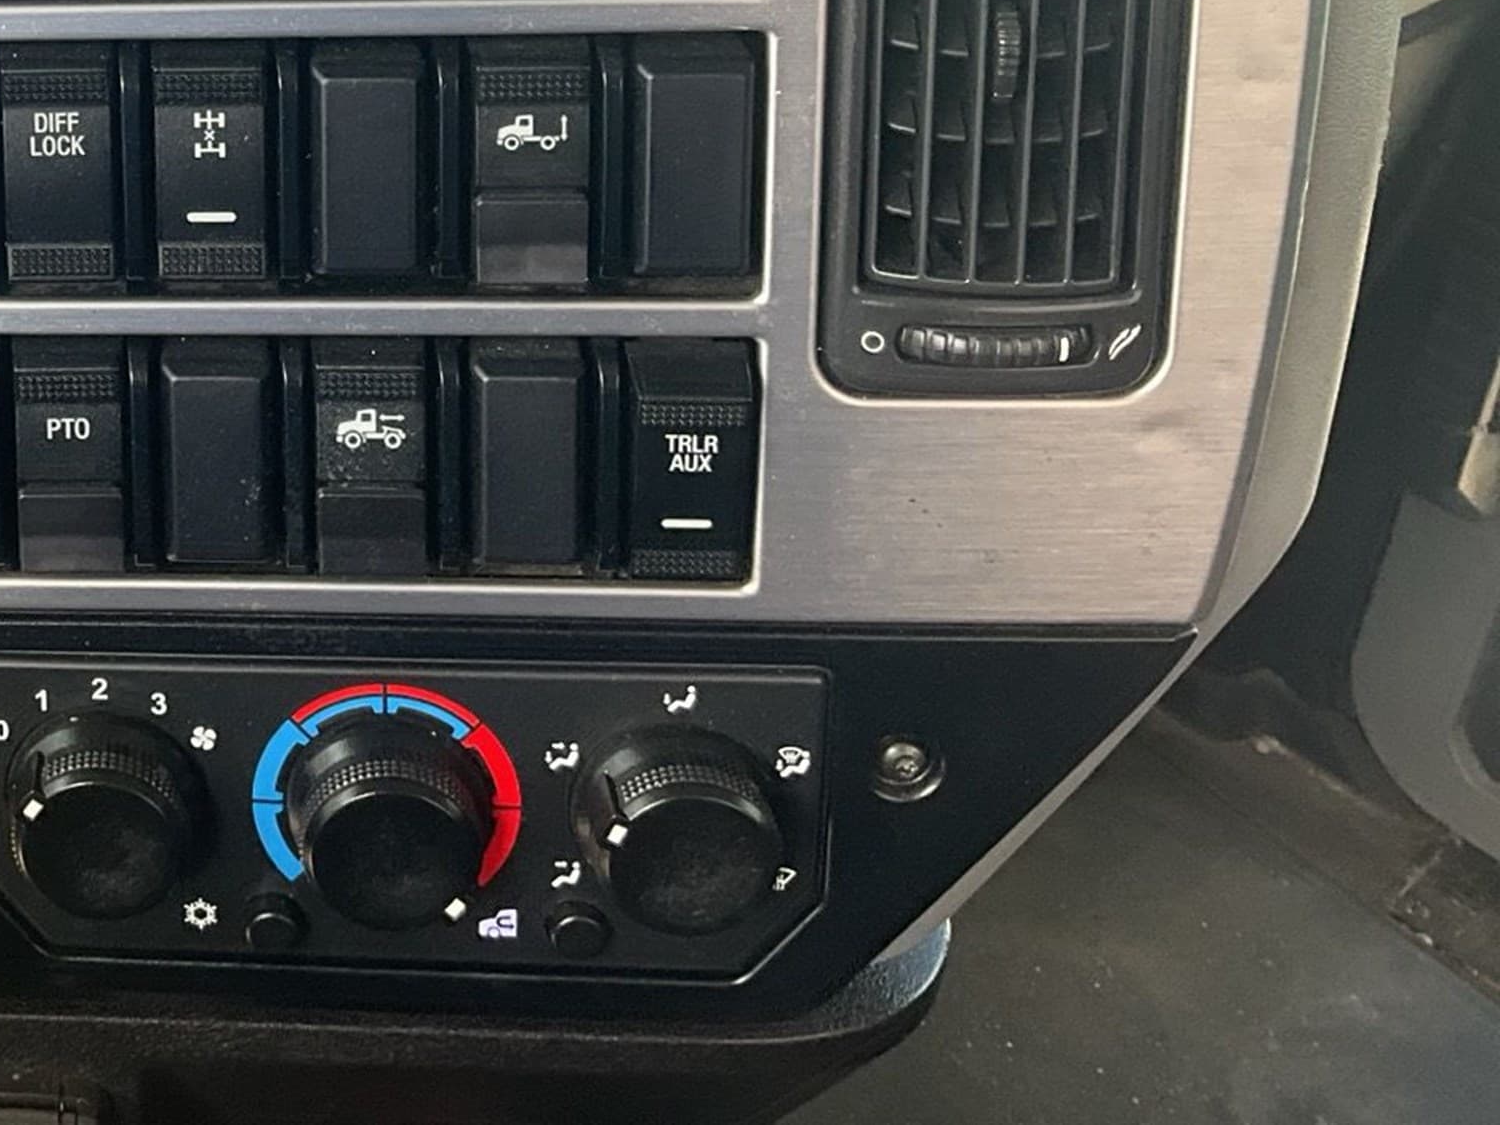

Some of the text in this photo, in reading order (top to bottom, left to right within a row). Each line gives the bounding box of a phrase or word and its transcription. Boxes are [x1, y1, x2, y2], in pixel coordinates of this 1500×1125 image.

[34, 112, 80, 134] DIFF
[29, 133, 86, 157] LOCK
[46, 418, 91, 442] PTO
[664, 433, 719, 455] TRLR
[667, 453, 713, 473] AUX
[35, 689, 47, 711] 1
[90, 678, 108, 700] 2
[151, 693, 168, 715] 3
